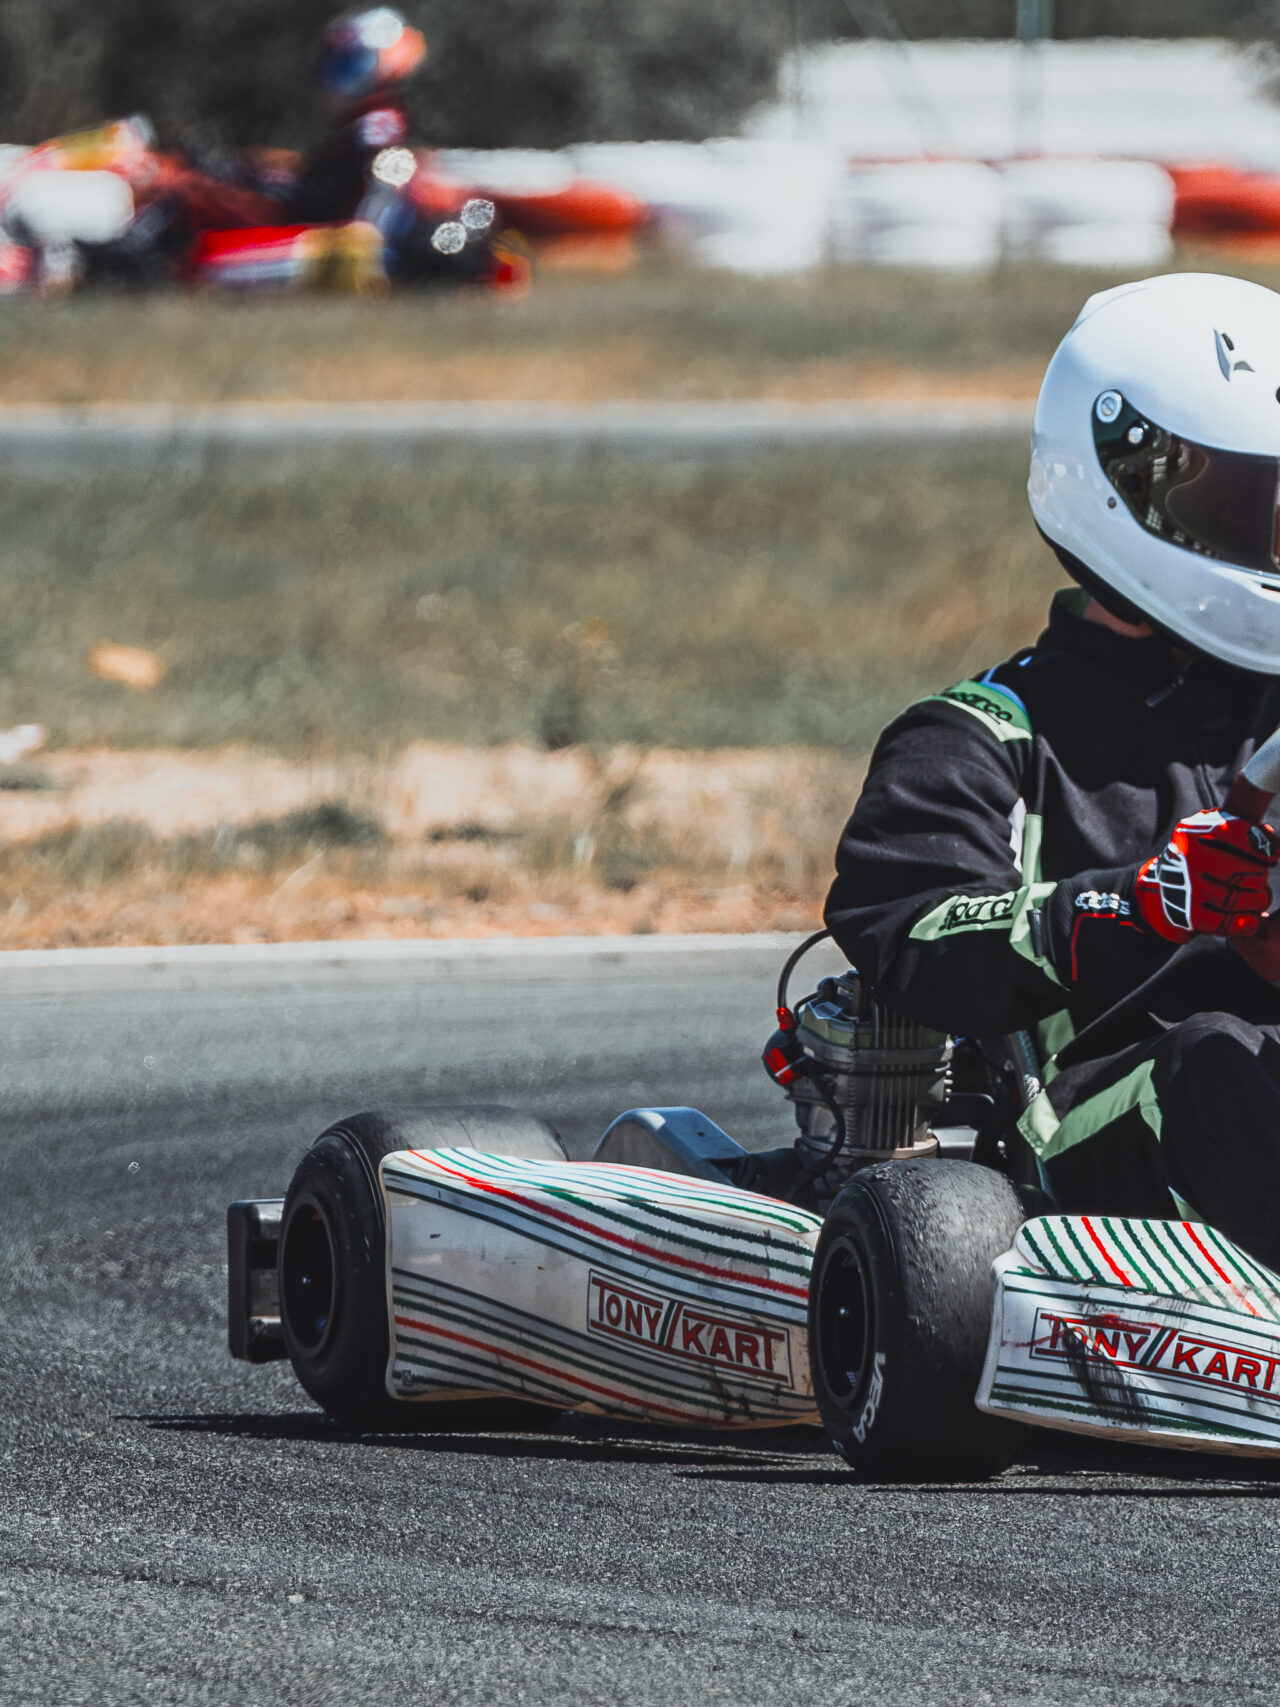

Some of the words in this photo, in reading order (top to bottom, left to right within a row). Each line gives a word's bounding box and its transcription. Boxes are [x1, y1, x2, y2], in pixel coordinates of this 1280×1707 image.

[592, 1277, 664, 1342] TONY
[682, 1310, 786, 1373] KART
[1040, 1313, 1151, 1361] TONY
